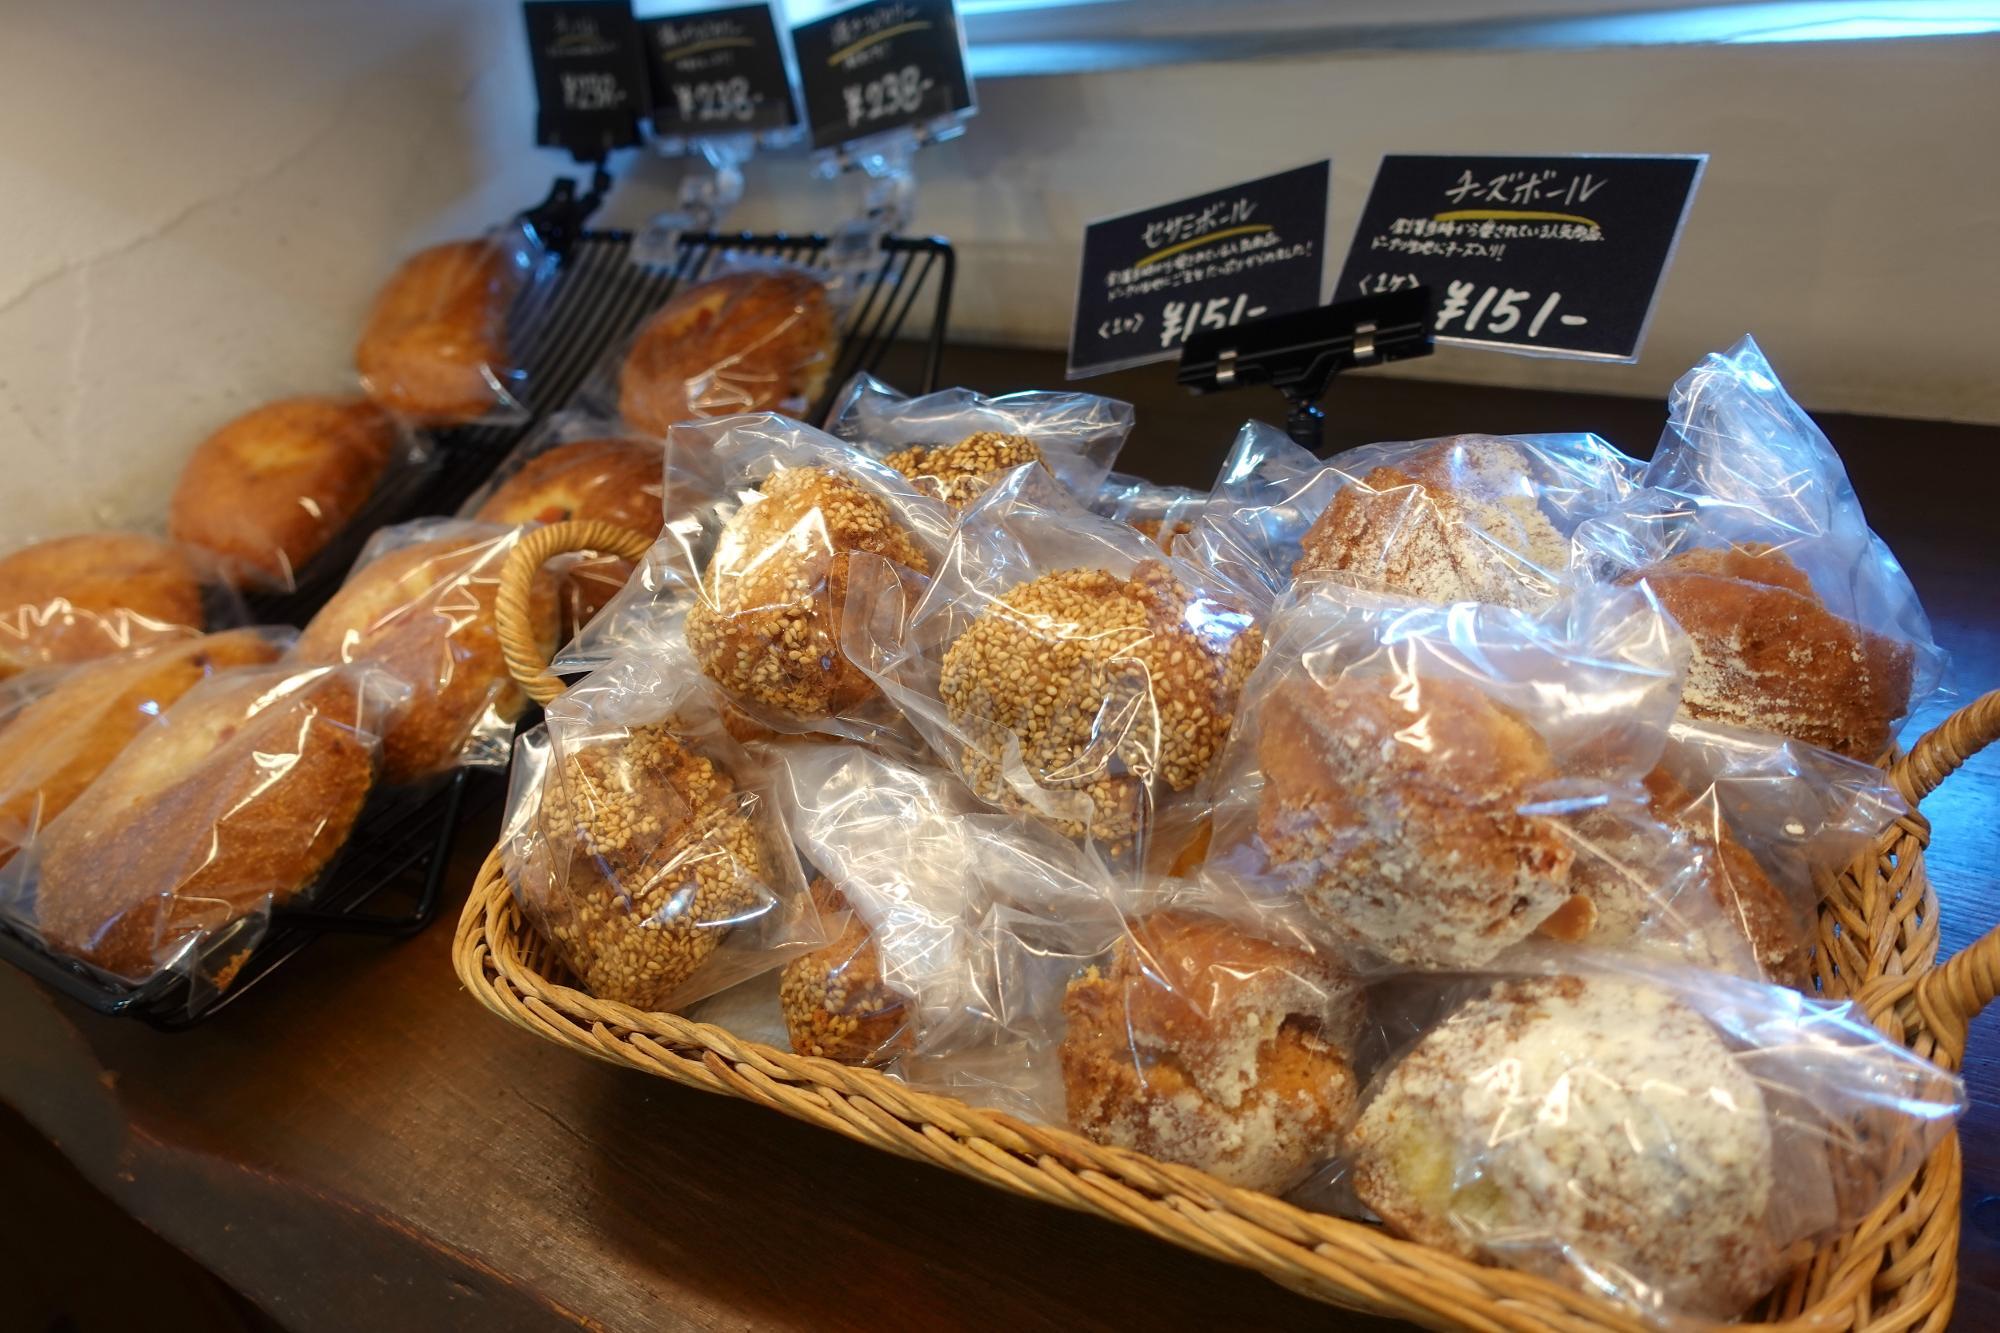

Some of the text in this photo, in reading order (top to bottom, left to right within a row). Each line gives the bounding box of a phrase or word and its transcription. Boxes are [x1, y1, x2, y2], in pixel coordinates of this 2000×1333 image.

[1445, 169, 1608, 205] チーズボール
[1434, 279, 1588, 338] ¥151-
